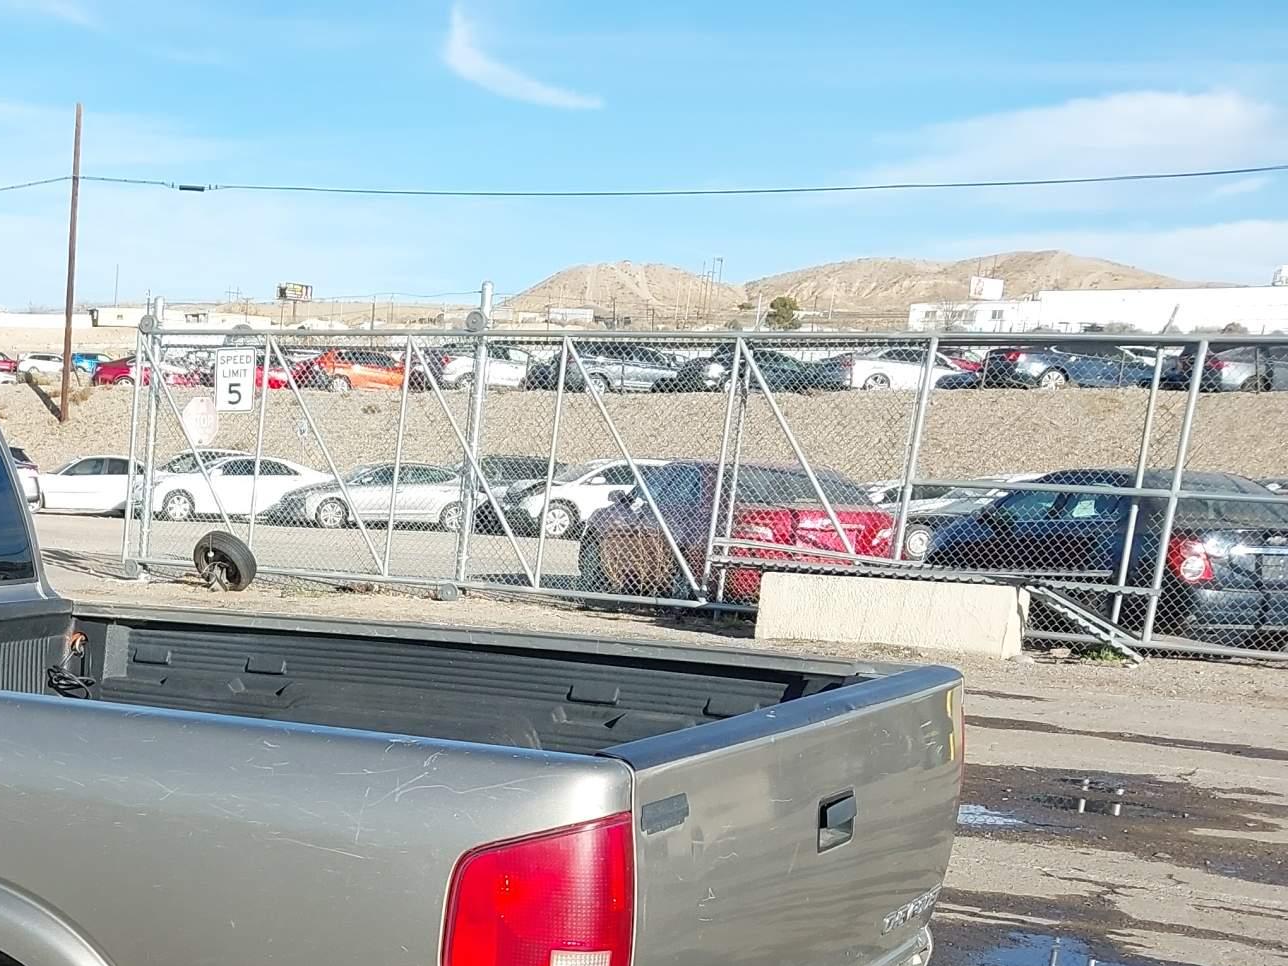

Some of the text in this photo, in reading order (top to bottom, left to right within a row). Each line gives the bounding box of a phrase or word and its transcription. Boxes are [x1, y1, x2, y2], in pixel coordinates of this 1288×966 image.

[219, 354, 253, 365] SPEED
[222, 368, 249, 378] LIMIT
[227, 382, 243, 405] 5
